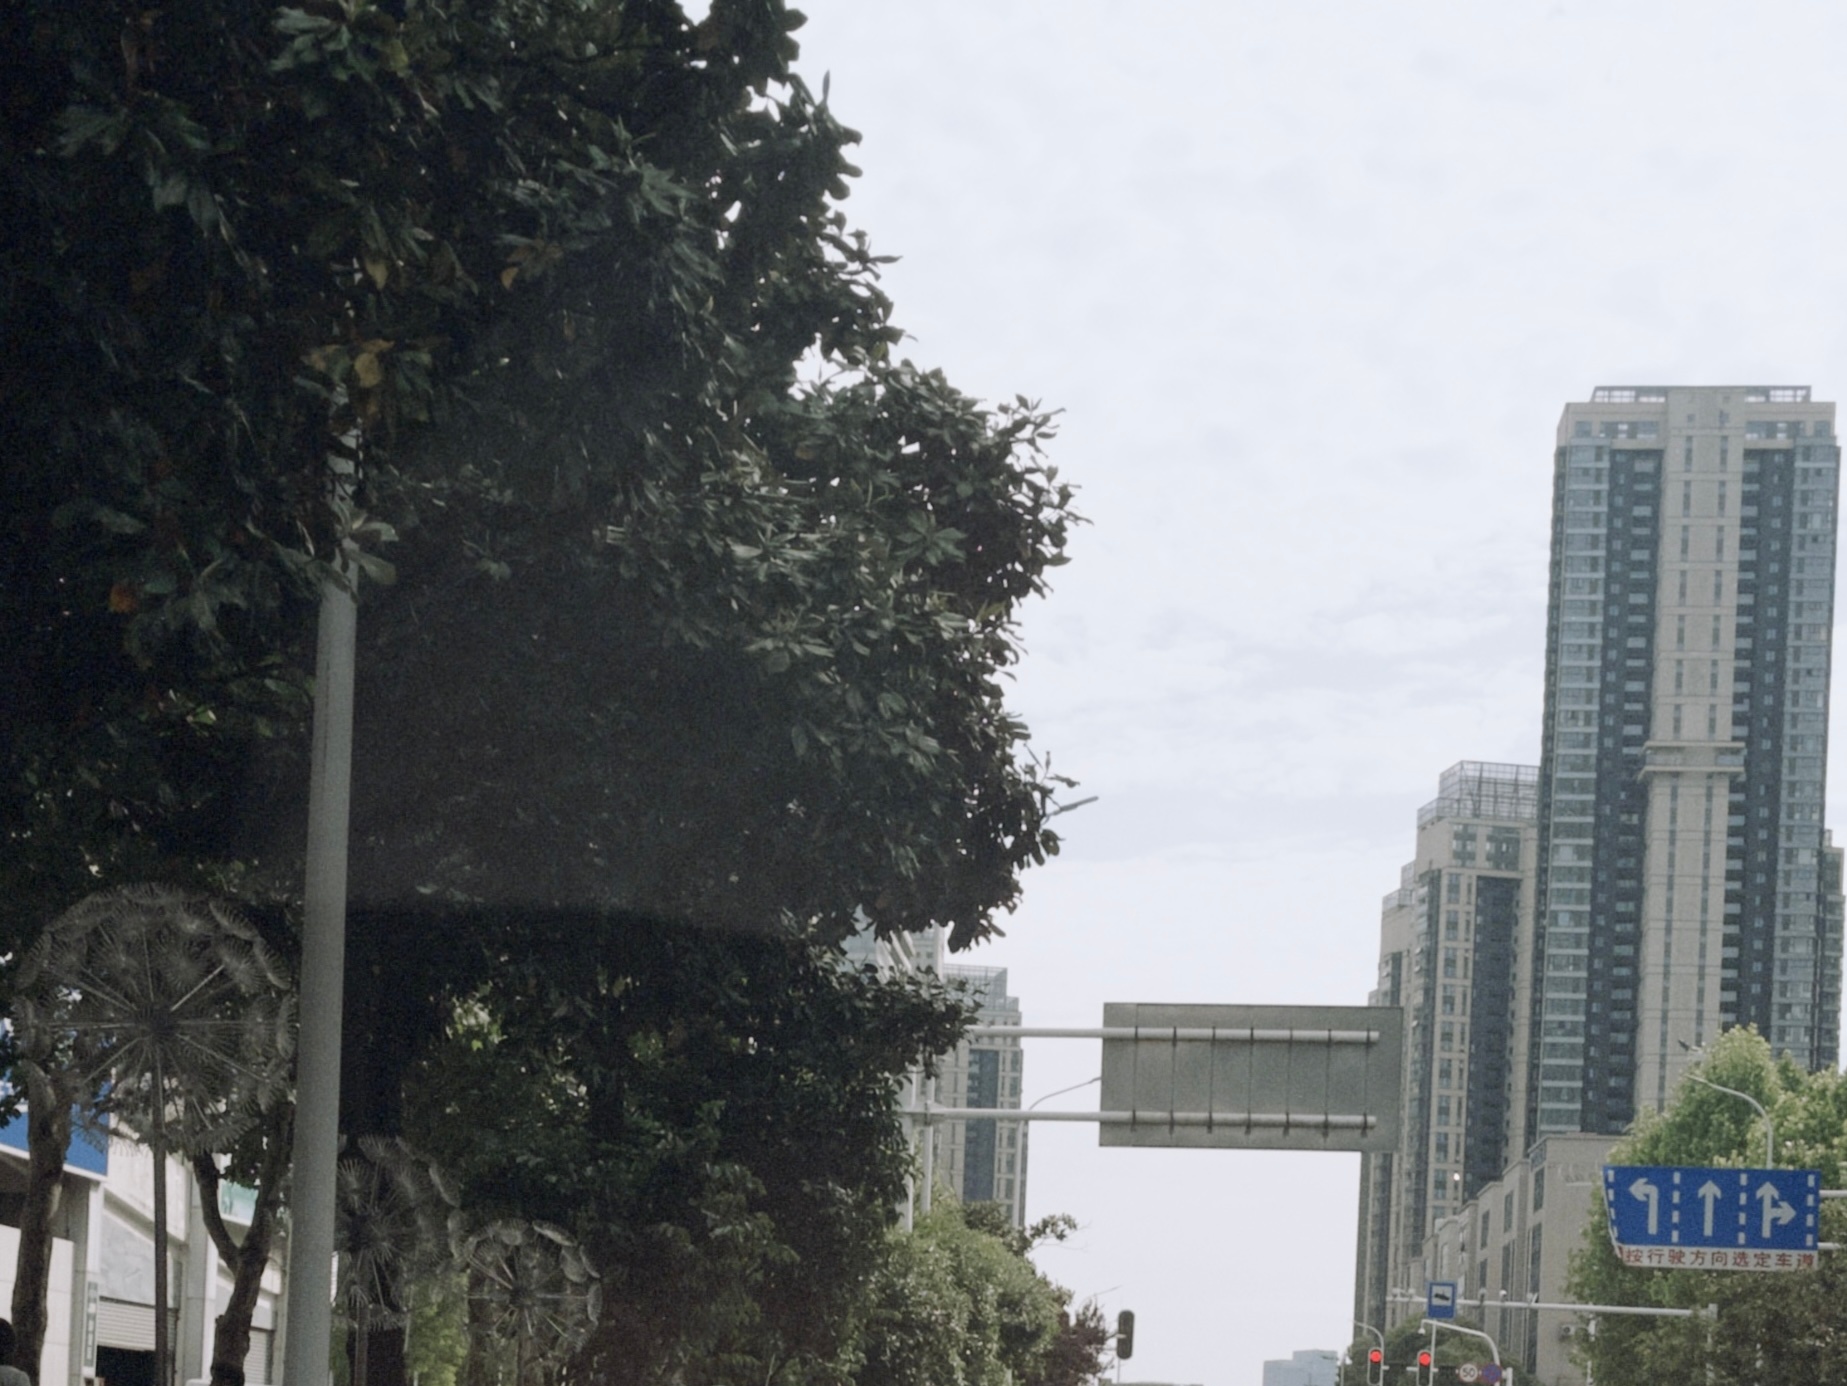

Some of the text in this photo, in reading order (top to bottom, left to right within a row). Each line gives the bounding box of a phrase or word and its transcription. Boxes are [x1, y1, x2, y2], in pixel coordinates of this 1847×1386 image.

[1625, 1247, 1814, 1268] 按行驶方向选定车道
[1462, 1367, 1476, 1378] 50
